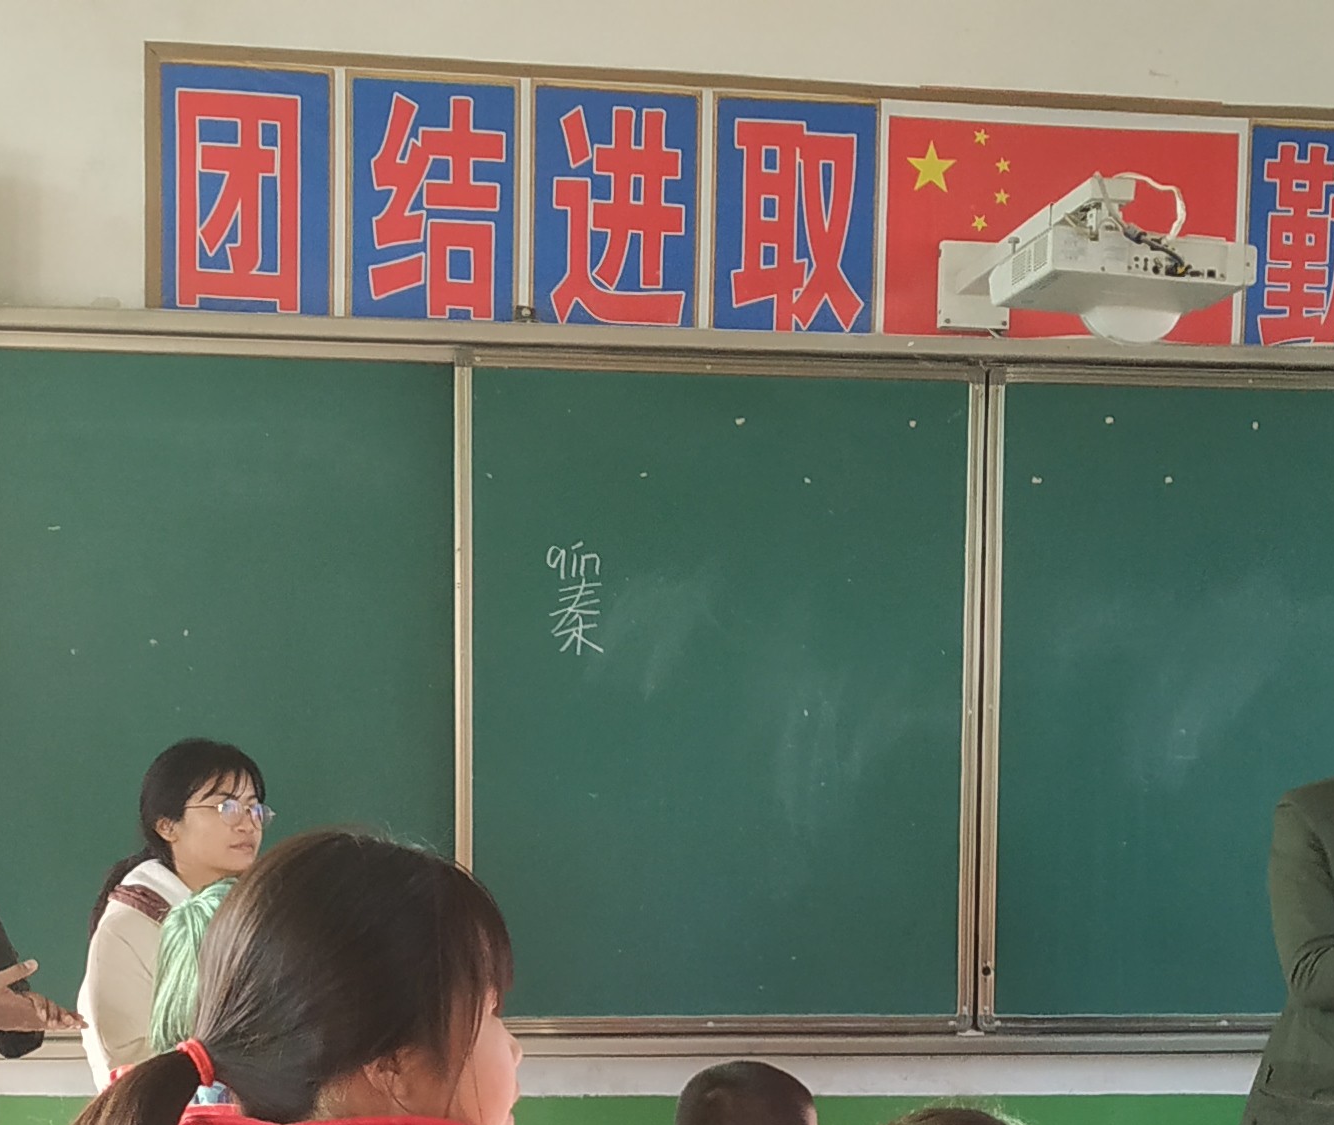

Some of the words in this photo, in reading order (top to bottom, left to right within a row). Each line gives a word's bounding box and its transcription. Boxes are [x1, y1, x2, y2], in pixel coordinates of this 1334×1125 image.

[175, 88, 864, 333] 团结进取
[546, 540, 601, 580] qín
